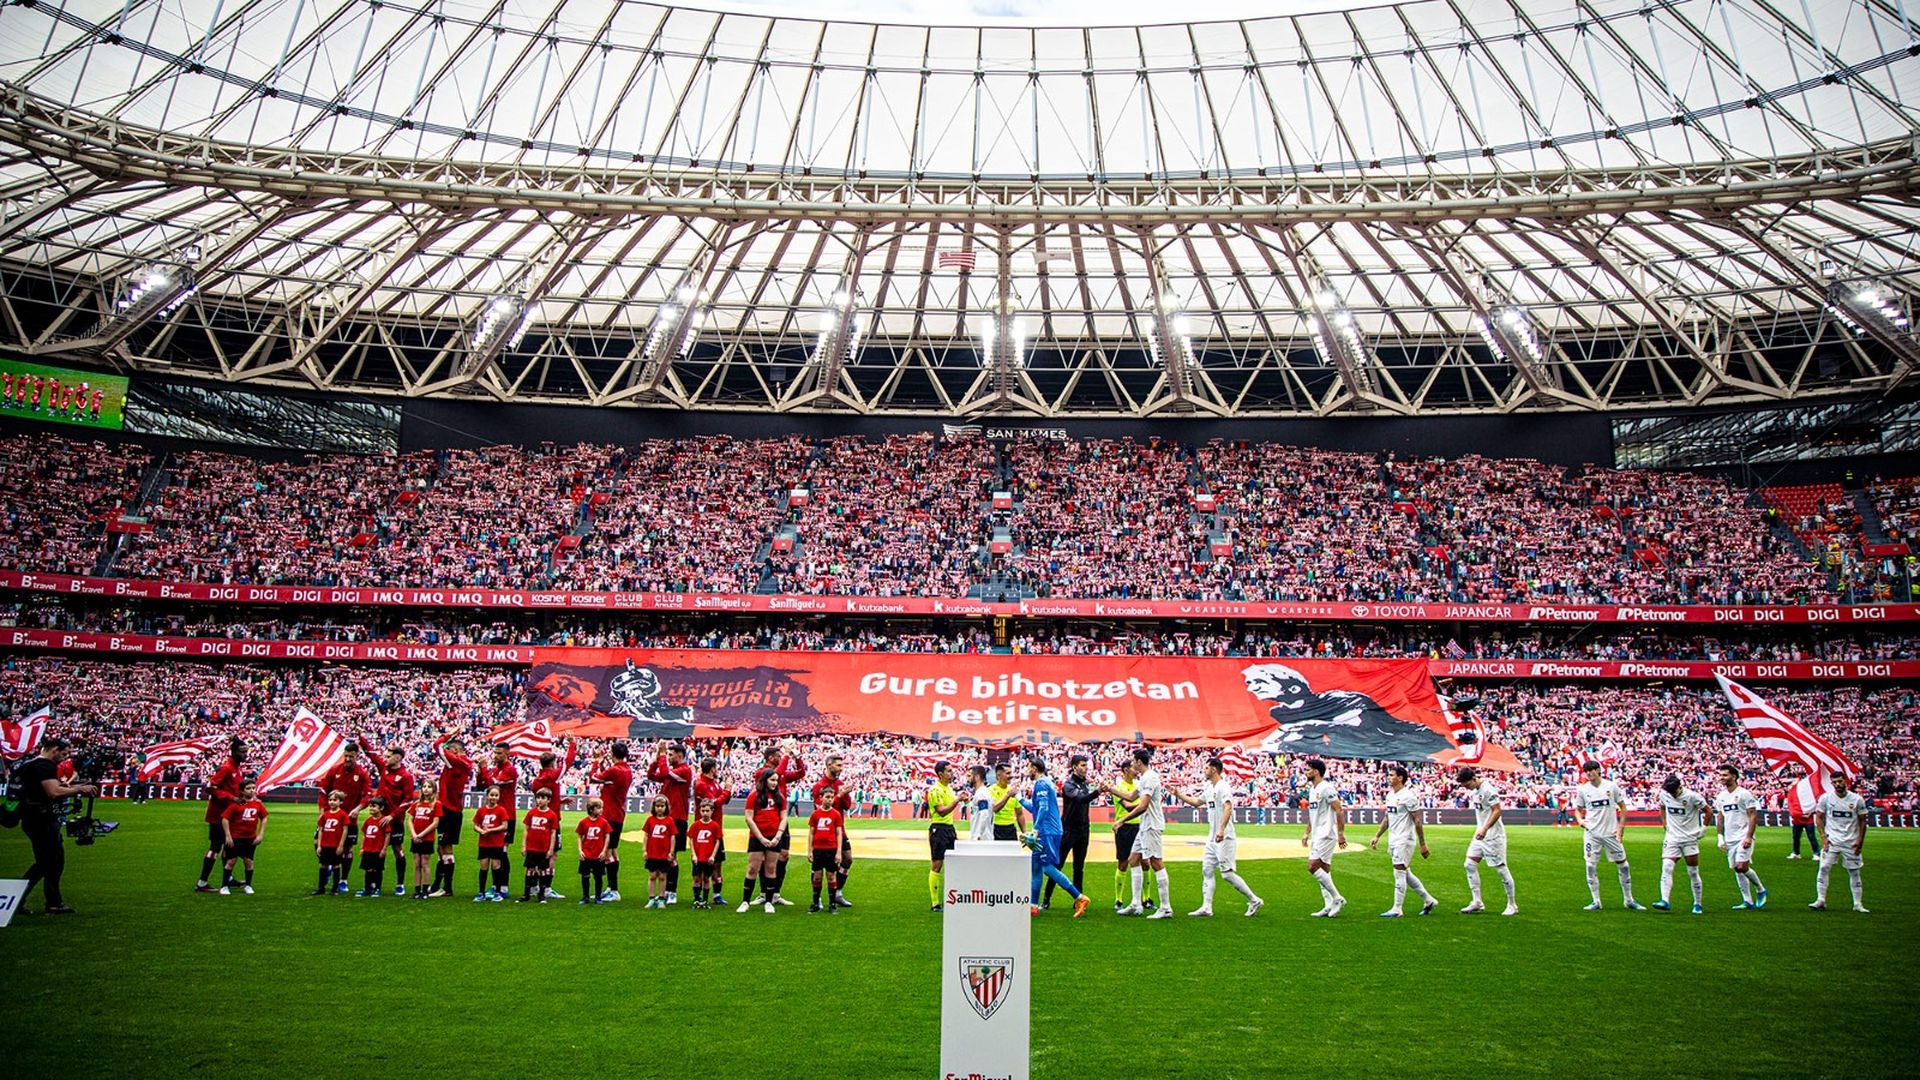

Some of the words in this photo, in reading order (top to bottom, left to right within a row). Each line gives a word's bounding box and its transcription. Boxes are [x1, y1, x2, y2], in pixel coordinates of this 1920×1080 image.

[987, 430, 1013, 438] SAN
[210, 589, 238, 599] DIGI
[250, 589, 277, 600] DIGI
[293, 591, 320, 601] DIGI
[332, 591, 359, 602] DIGI
[373, 592, 404, 604] IMQ
[414, 593, 444, 604] IMQ
[452, 593, 482, 605] IMQ
[615, 594, 642, 602] CLUB
[655, 594, 683, 602] CLUB
[493, 594, 523, 606] IMQ
[859, 604, 904, 612] kutxabank
[946, 604, 991, 614] kutxabank
[1032, 605, 1077, 615] kutxabank
[1108, 607, 1152, 615] kutxabank
[1373, 606, 1425, 617] TOYOTA
[1446, 607, 1511, 617] JAPANCAR
[1546, 607, 1600, 620] Petronor
[1852, 608, 1884, 618] DIGI
[1632, 608, 1686, 620] Petronor
[1715, 610, 1743, 620] DIGI
[1754, 610, 1783, 620] DIGI
[1808, 609, 1839, 620] DIGI
[202, 643, 230, 653] DIGI
[242, 644, 270, 655] DIGI
[287, 645, 314, 656] DIGI
[326, 646, 353, 657] DIGI
[368, 647, 398, 659] IMQ
[407, 648, 438, 660] IMQ
[447, 649, 477, 660] IMQ
[488, 650, 518, 661] IMQ
[1448, 664, 1514, 674] JAPANCAR
[1547, 664, 1602, 676] Petronor
[1634, 664, 1689, 676] Petronor
[1717, 666, 1745, 677] DIGI
[1757, 666, 1786, 676] DIGI
[1813, 666, 1844, 676] DIGI
[1858, 665, 1890, 675] DIGI
[766, 680, 790, 694] IN
[859, 672, 958, 696] Gure
[972, 673, 1198, 699] bihotzetan
[710, 693, 793, 709] WORLD
[931, 701, 1117, 726] betirako
[946, 889, 1013, 907] SanMiguel
[974, 1000, 998, 1016] BILBAO
